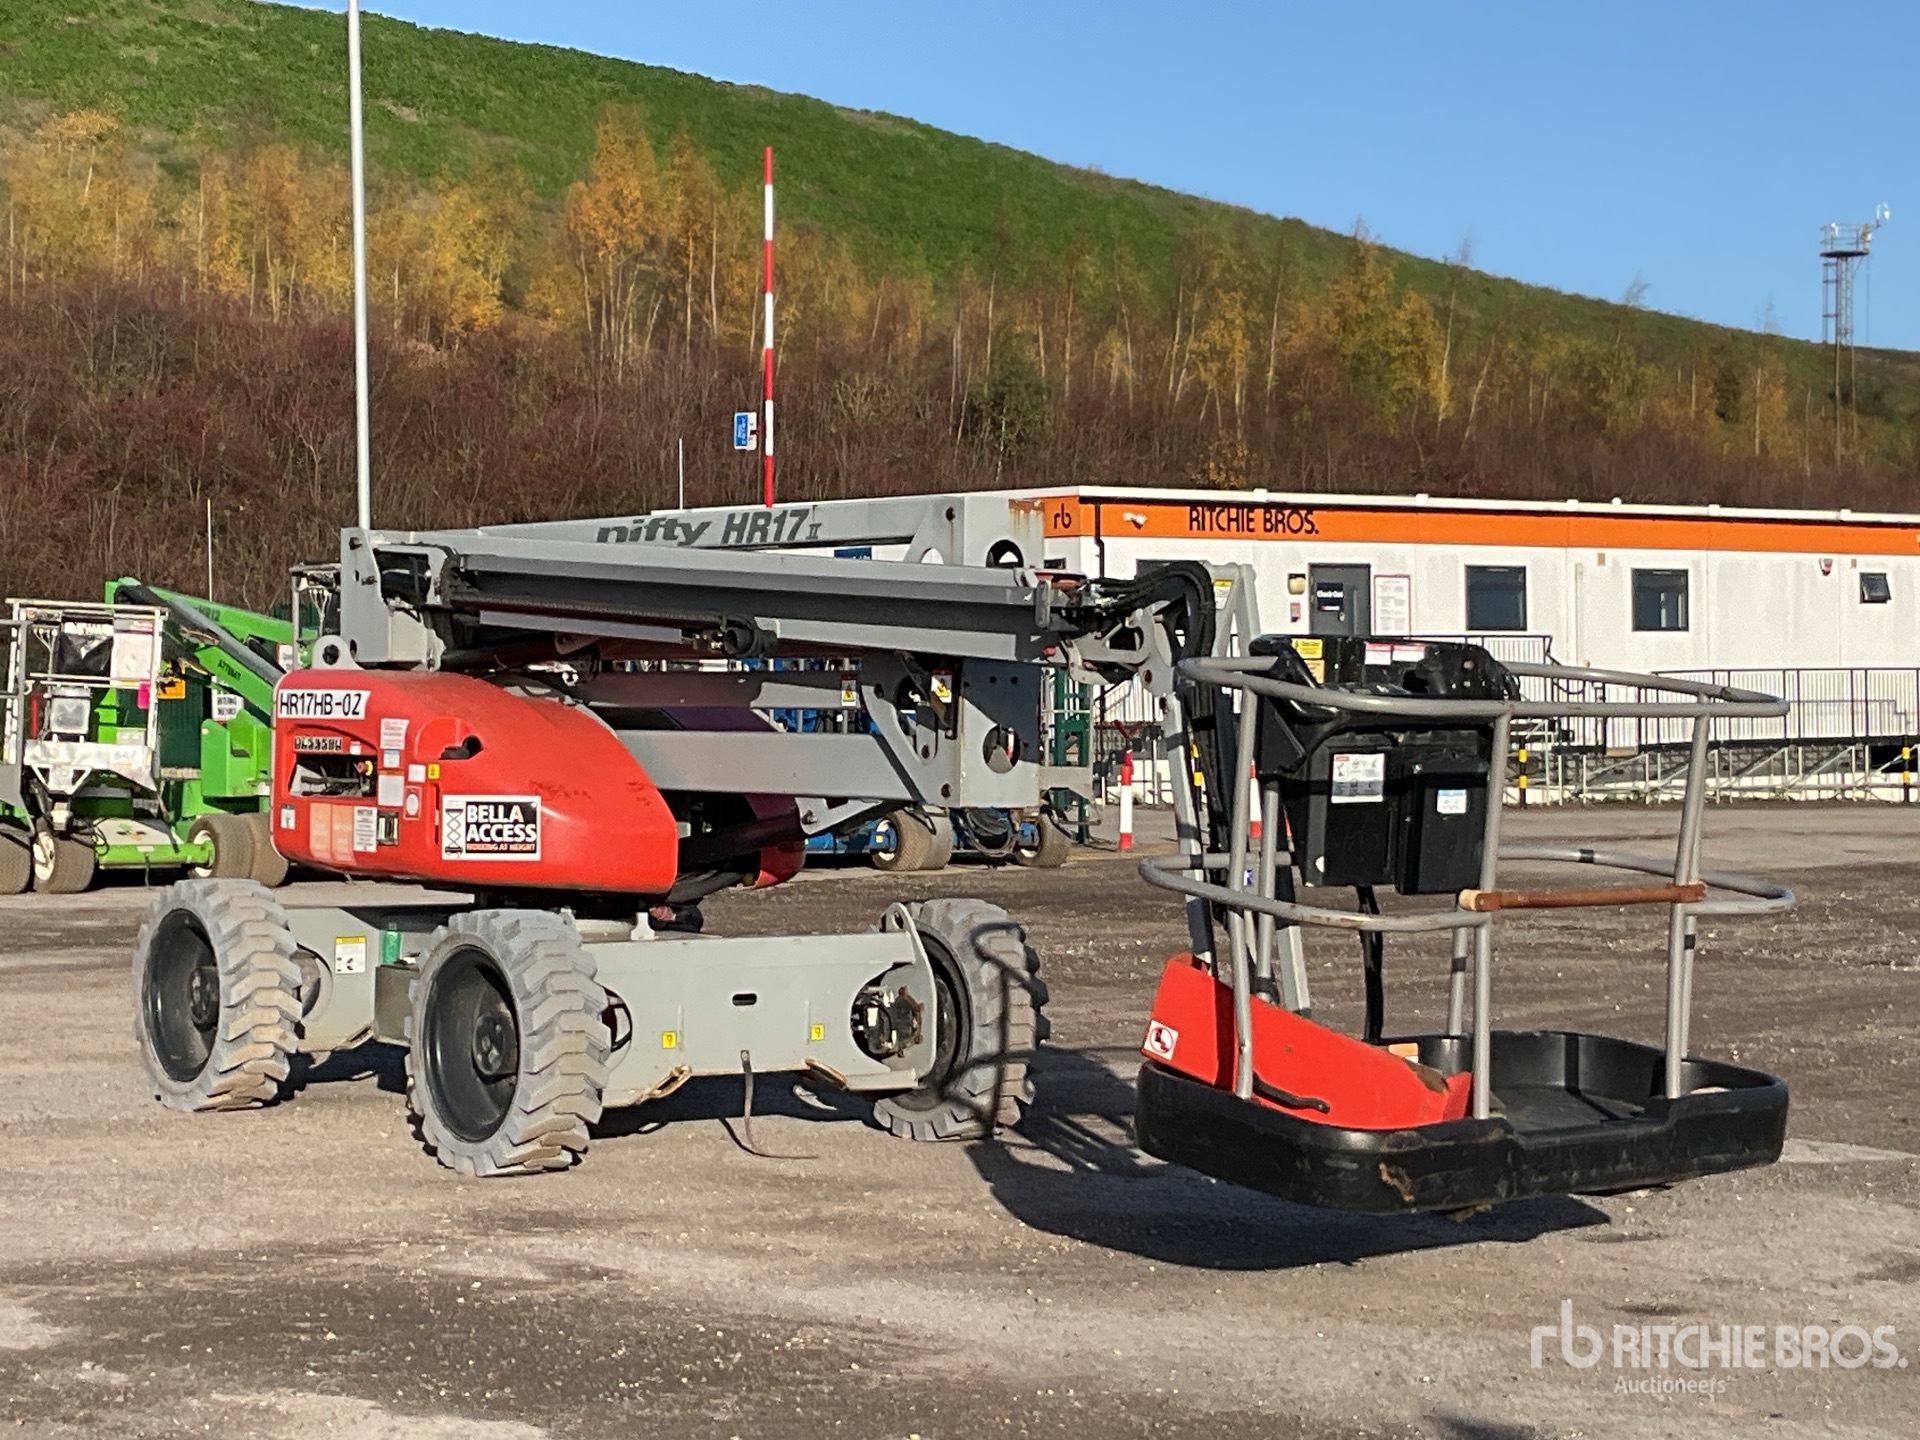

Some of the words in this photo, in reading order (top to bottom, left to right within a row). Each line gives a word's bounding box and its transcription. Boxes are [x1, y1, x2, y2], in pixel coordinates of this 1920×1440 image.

[596, 516, 713, 547] nifty
[720, 509, 810, 545] HR17
[1053, 503, 1073, 530] rb
[1189, 507, 1255, 533] RITCHIE
[1263, 509, 1320, 535] BROS.
[279, 692, 362, 717] HR17HB-02
[466, 804, 524, 823] BELLA
[466, 823, 537, 843] ACCESS
